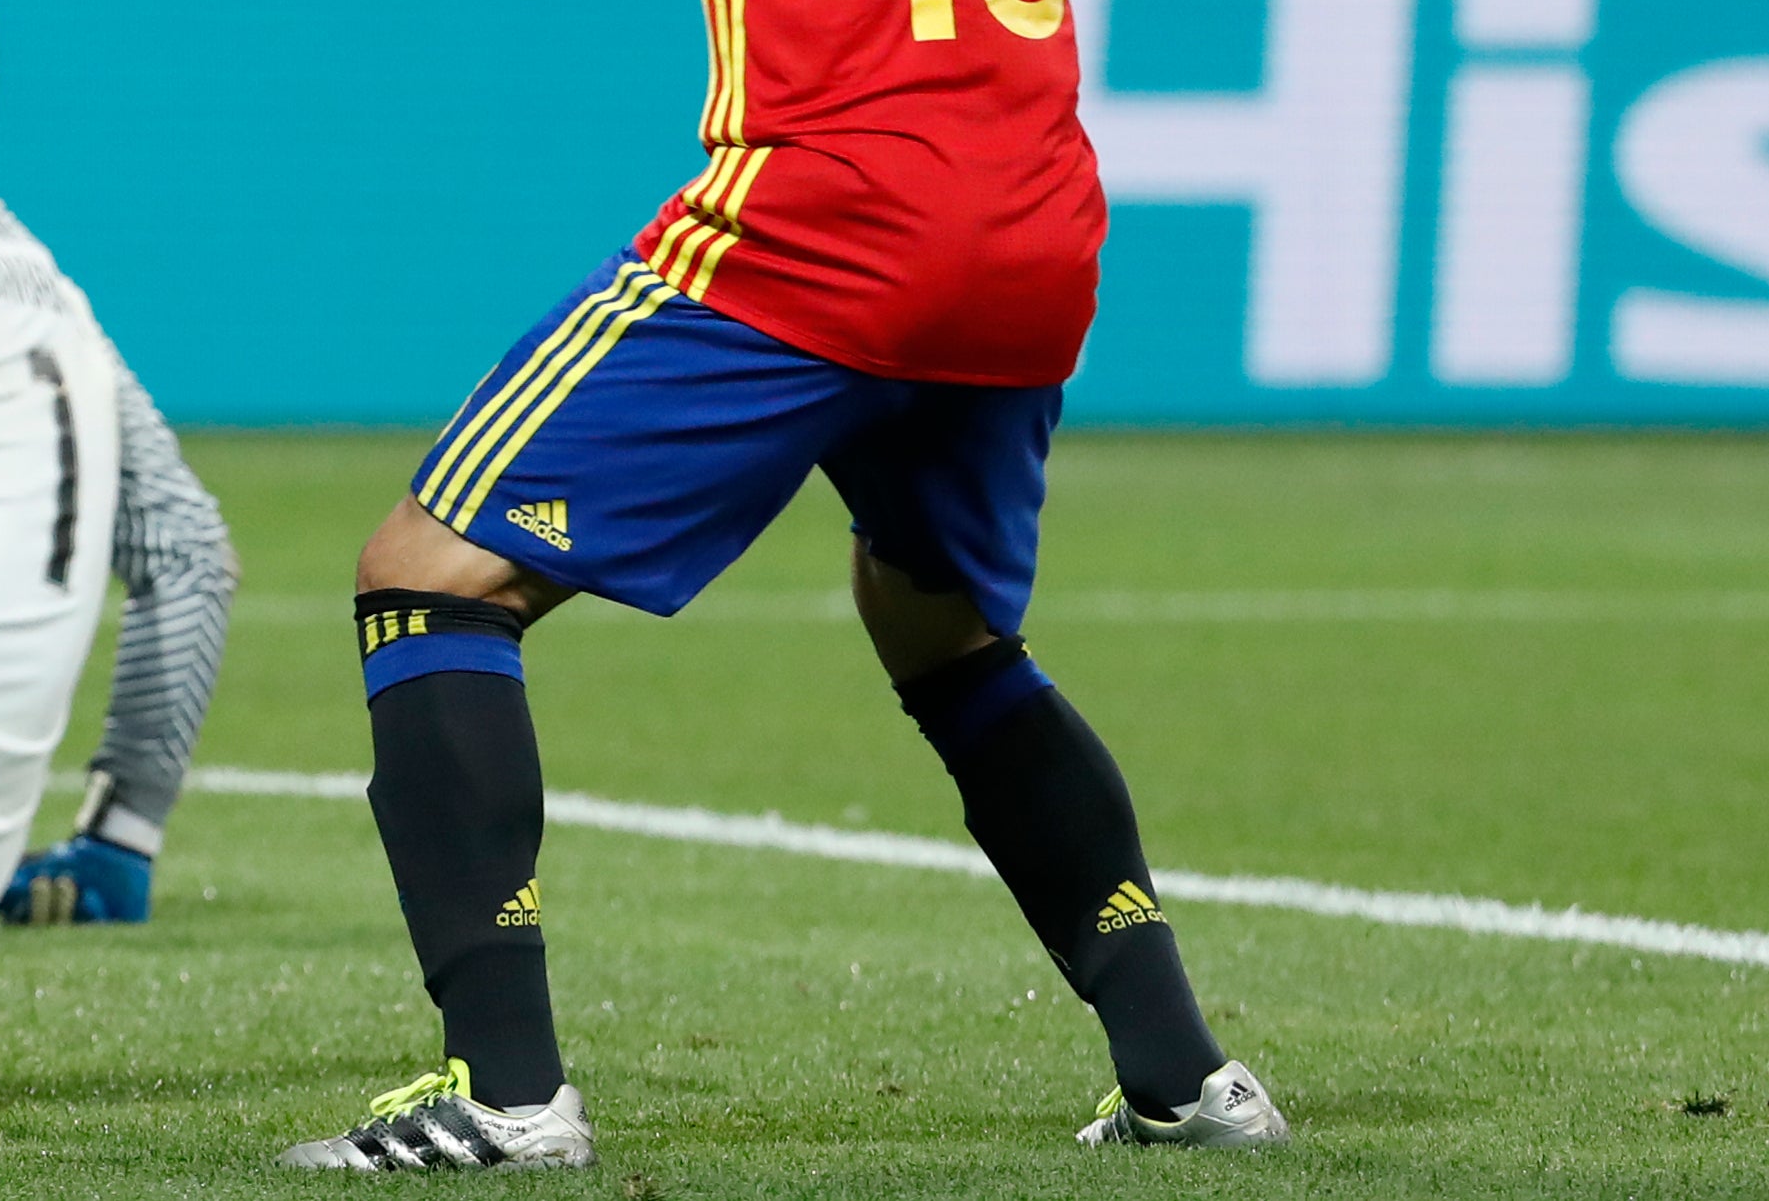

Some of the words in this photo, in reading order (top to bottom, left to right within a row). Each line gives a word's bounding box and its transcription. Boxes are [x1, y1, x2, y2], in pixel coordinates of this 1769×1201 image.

[27, 347, 80, 591] 1
[505, 508, 573, 552] adidas
[496, 908, 541, 927] adid
[1096, 907, 1168, 934] adidas
